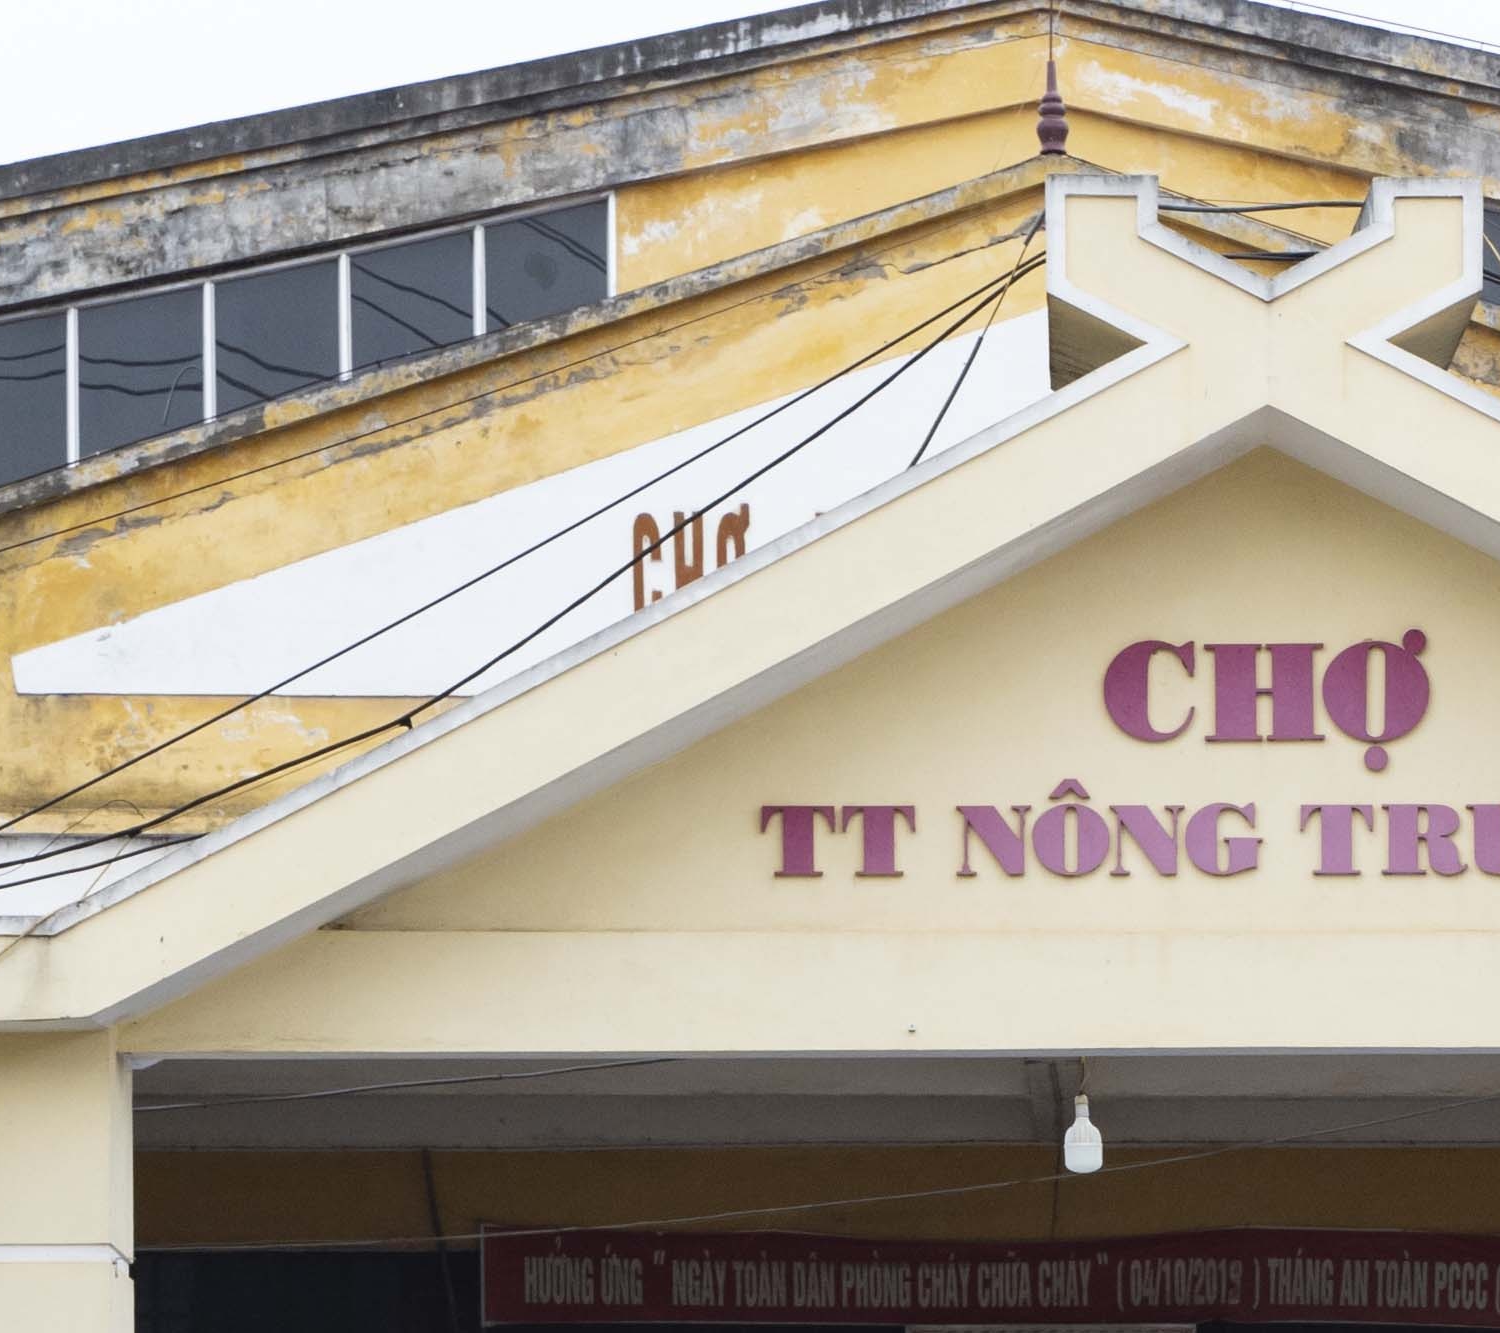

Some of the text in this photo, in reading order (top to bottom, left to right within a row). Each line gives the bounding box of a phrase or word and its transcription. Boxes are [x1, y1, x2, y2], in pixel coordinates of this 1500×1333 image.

[1103, 628, 1430, 773] CHỢ
[760, 804, 916, 878] TT
[956, 778, 1263, 879] NÔNG
[672, 1250, 725, 1307] NGÀY
[734, 1251, 787, 1306] TOÀN
[793, 1251, 835, 1306] DÂN
[842, 1250, 911, 1308] PHÒNG
[917, 1253, 971, 1308] CHÁY
[977, 1249, 1032, 1308] CHỮA
[1038, 1253, 1090, 1307] CHÁY
[1267, 1248, 1334, 1308] THÁNG
[1340, 1260, 1368, 1308] AN
[1375, 1251, 1428, 1309] TOÀN
[1434, 1262, 1487, 1311] PCCC
